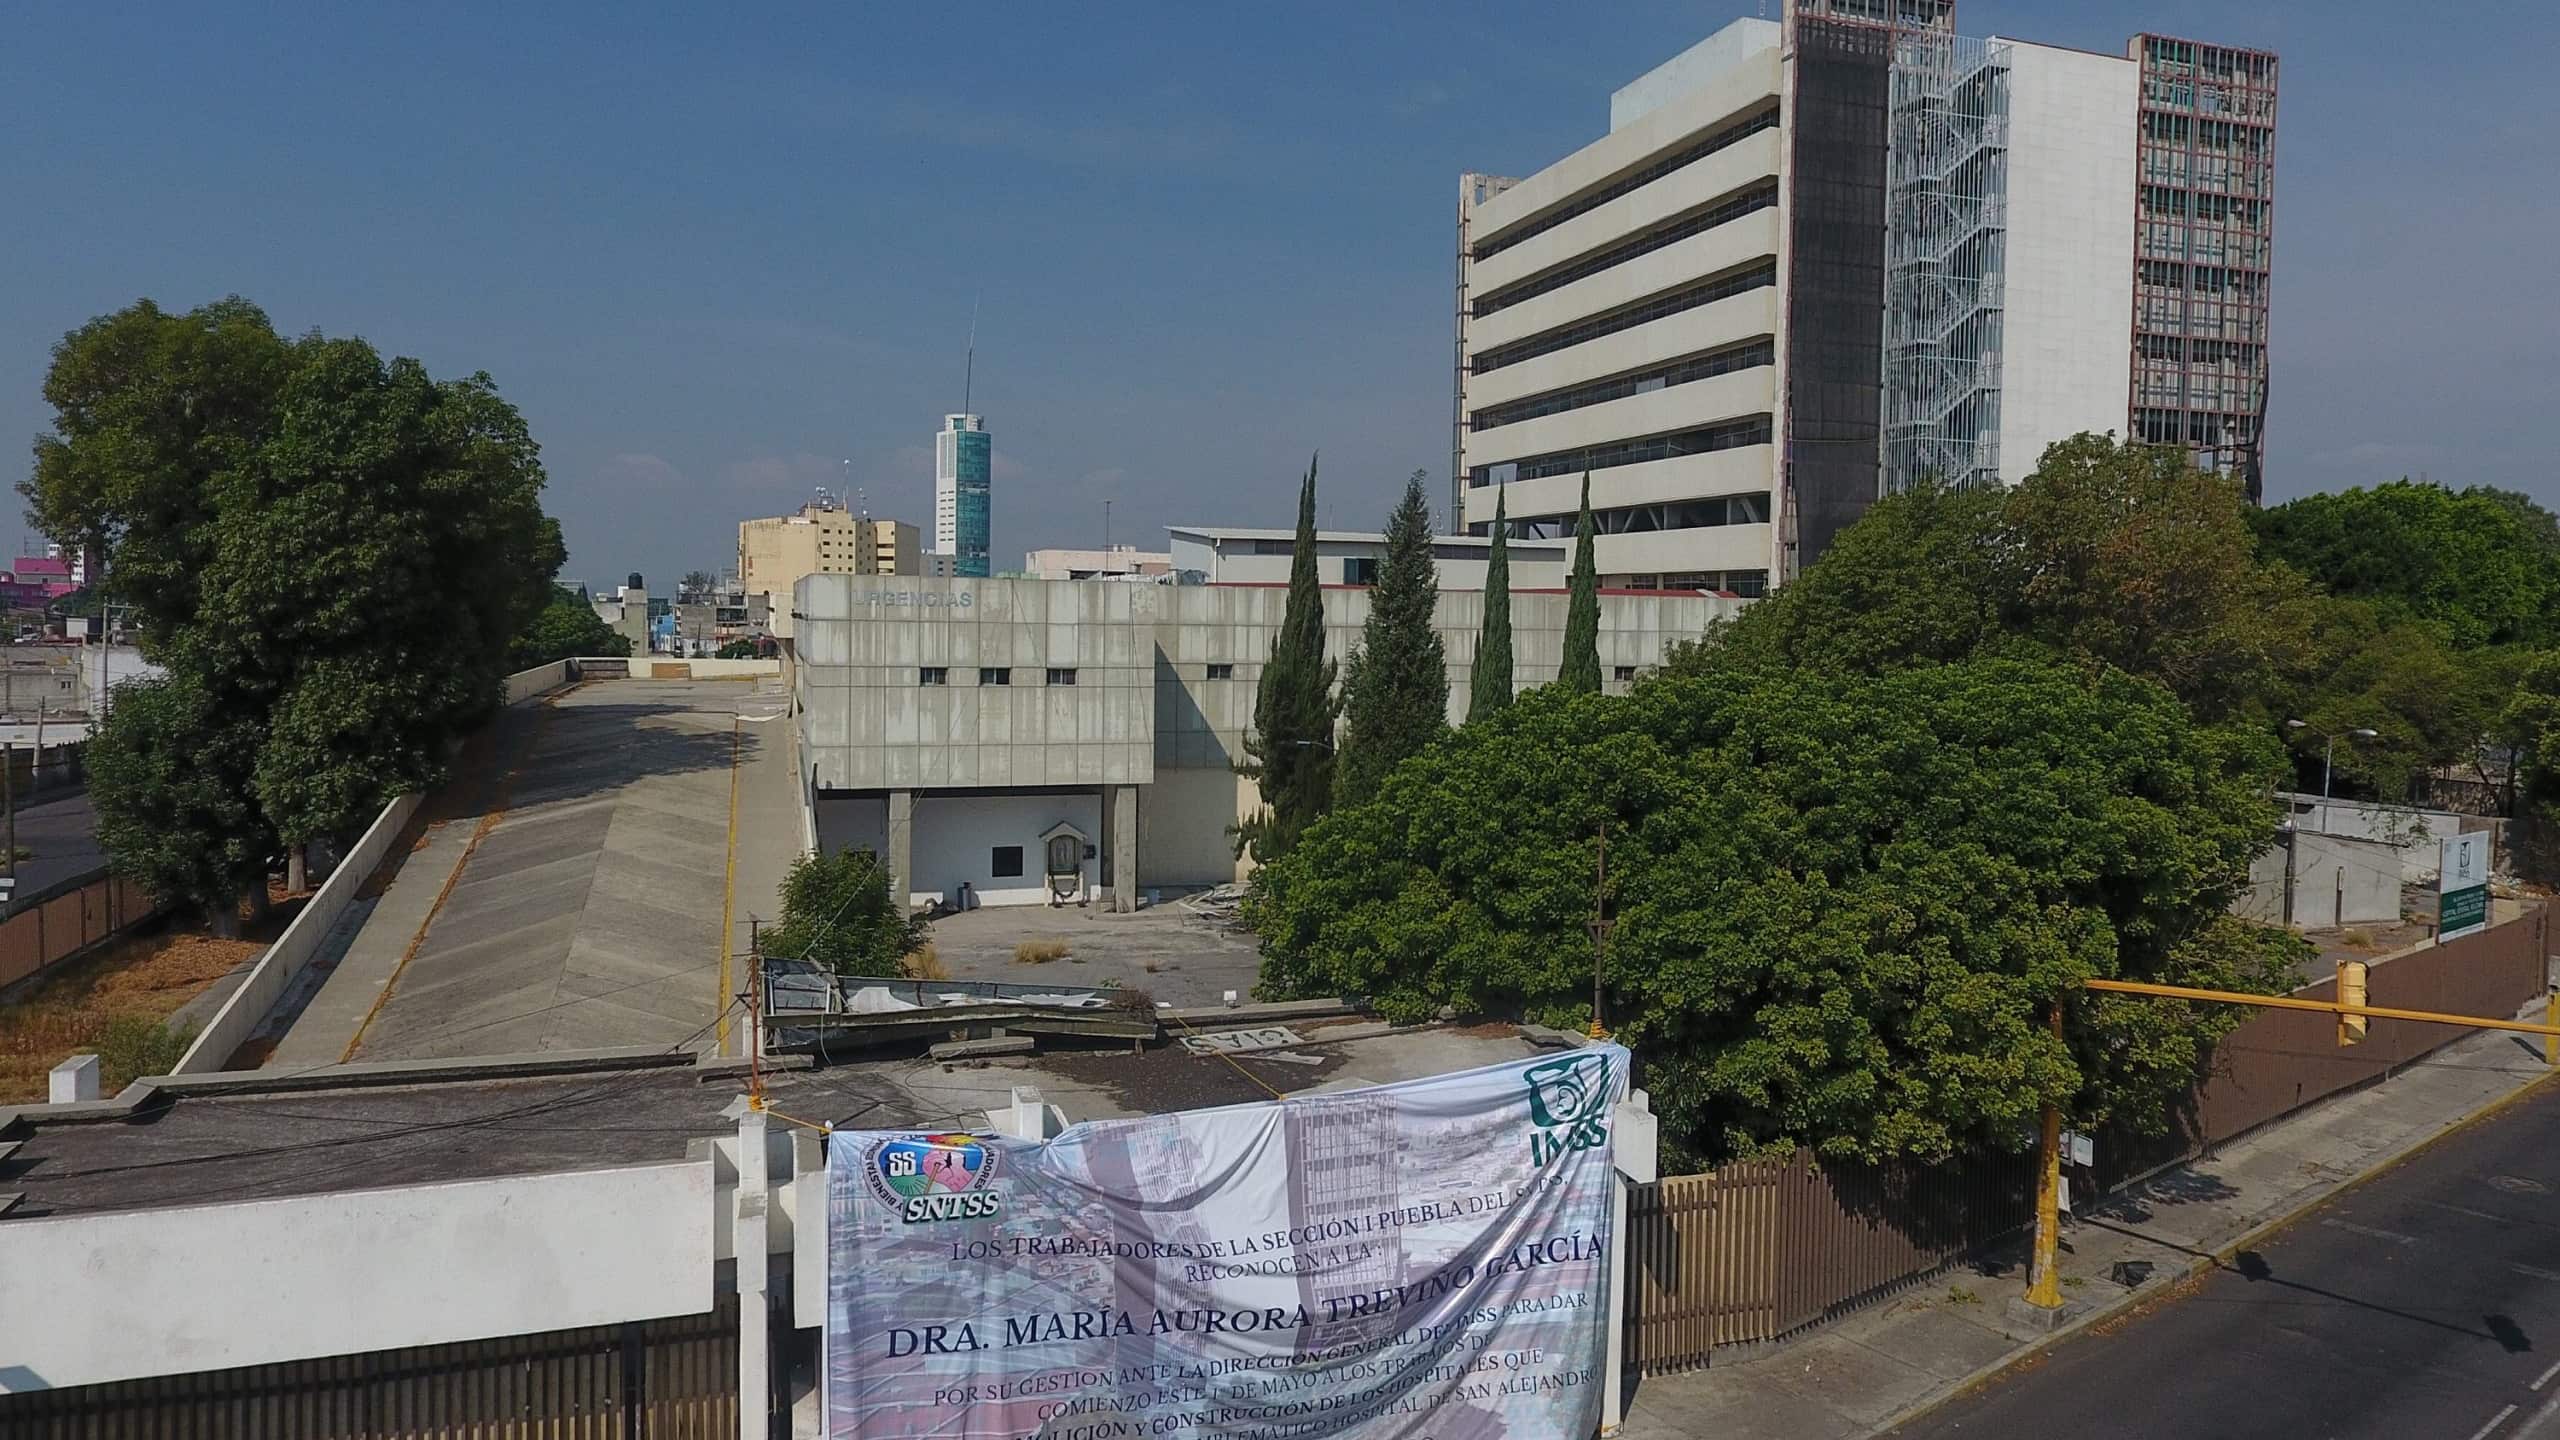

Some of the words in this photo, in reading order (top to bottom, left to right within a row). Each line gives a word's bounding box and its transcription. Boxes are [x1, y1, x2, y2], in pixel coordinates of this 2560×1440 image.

[854, 591, 972, 608] URGENCIAS
[905, 1191, 999, 1222] SNTSS
[951, 1239, 1001, 1261] LOS
[1009, 1237, 1193, 1260] TRABAJADORES
[1196, 1241, 1227, 1259] DE
[1231, 1236, 1258, 1257] LA
[1263, 1215, 1359, 1251] SECCIÓN
[1378, 1200, 1463, 1230] PUEBLA
[1468, 1191, 1511, 1214] DEL
[1186, 1251, 1320, 1283] RECONOCEN
[1327, 1249, 1340, 1266] A
[1345, 1242, 1372, 1262] LA
[886, 1321, 989, 1359] DRA.
[1003, 1305, 1136, 1348] MARÍA
[1148, 1303, 1313, 1336] AURORA
[1486, 1229, 1601, 1279] GARCÍA
[934, 1385, 978, 1407] POR
[986, 1382, 1012, 1400] SU
[1119, 1363, 1171, 1385] ANTE
[1178, 1364, 1205, 1379] LA
[1327, 1331, 1414, 1358] GENERAL
[1502, 1298, 1545, 1319] PARA
[1550, 1292, 1588, 1310] DAR
[1038, 1392, 1151, 1420] COMIENZO
[1158, 1386, 1207, 1405] ESTE
[1232, 1382, 1257, 1400] DE
[1262, 1371, 1317, 1396] MAYO
[1322, 1367, 1337, 1385] A
[1340, 1361, 1376, 1381] LOS
[1135, 1421, 1147, 1437] Y
[1152, 1400, 1313, 1435] CONSTRUCCIÓN
[1320, 1394, 1345, 1412] DE
[1350, 1387, 1384, 1405] LOS
[1388, 1355, 1500, 1394] HOSPITALES
[1504, 1348, 1544, 1372] QUE
[1333, 1396, 1423, 1429] HOSPITAL
[1456, 1382, 1491, 1402] SAN
